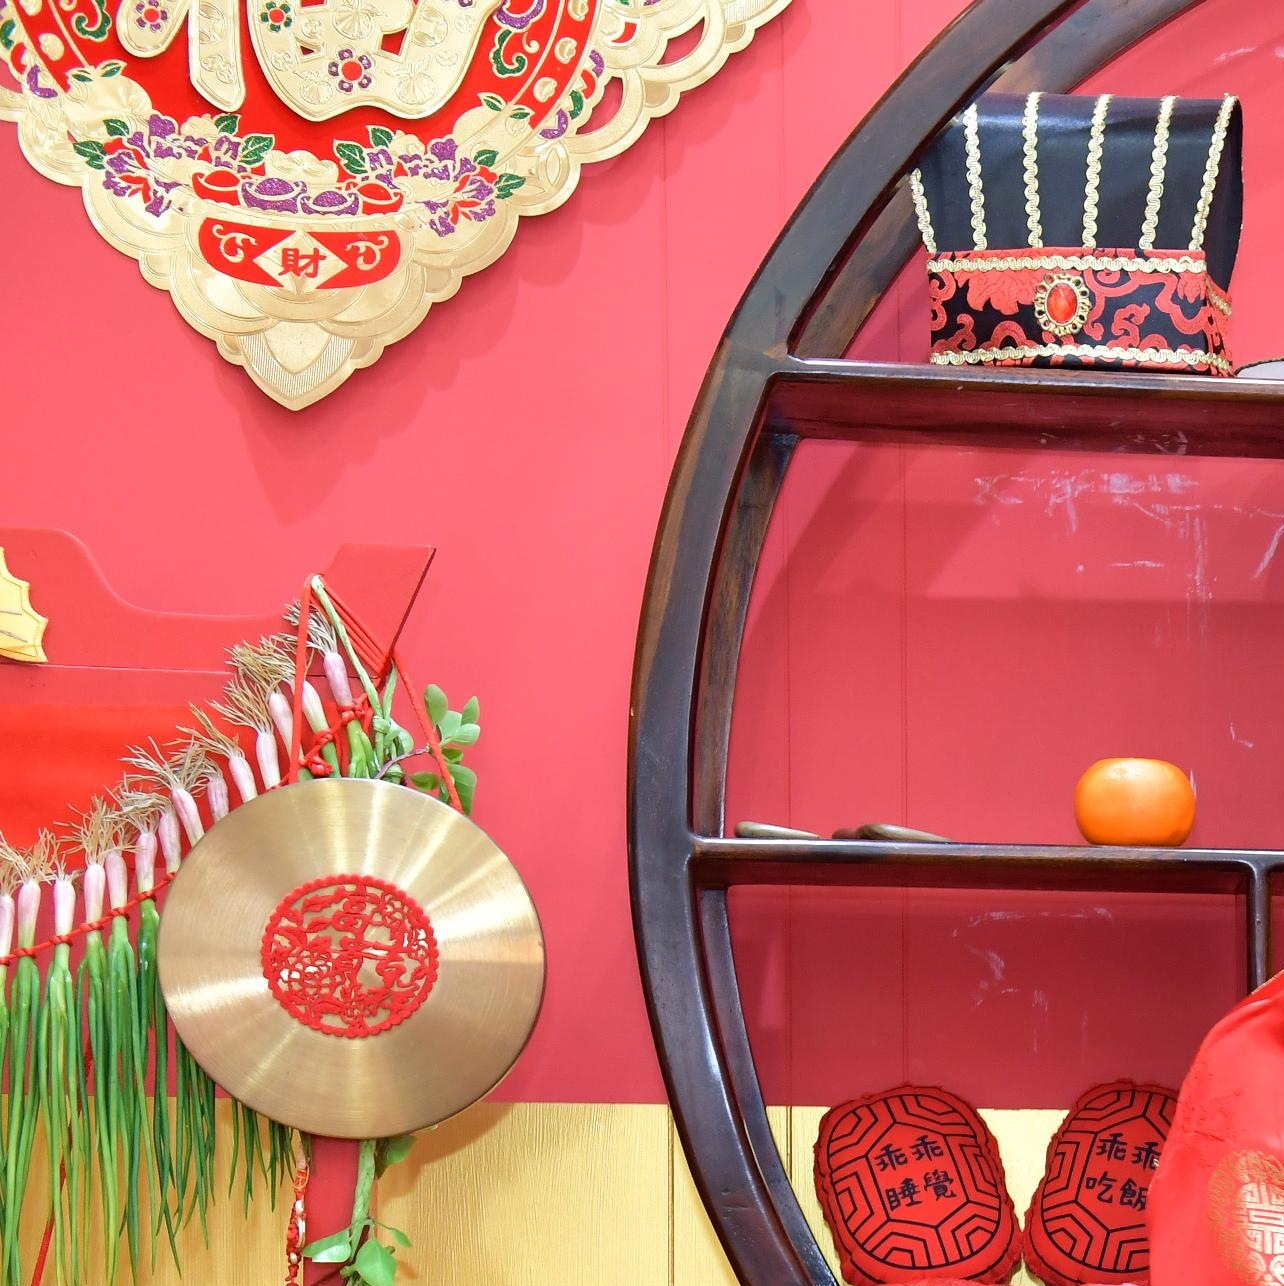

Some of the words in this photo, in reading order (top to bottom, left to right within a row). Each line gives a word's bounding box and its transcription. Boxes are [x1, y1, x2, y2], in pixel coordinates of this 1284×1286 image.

[279, 247, 325, 278] 財
[874, 1134, 944, 1172] 乖乖
[885, 1168, 957, 1212] 睡覺
